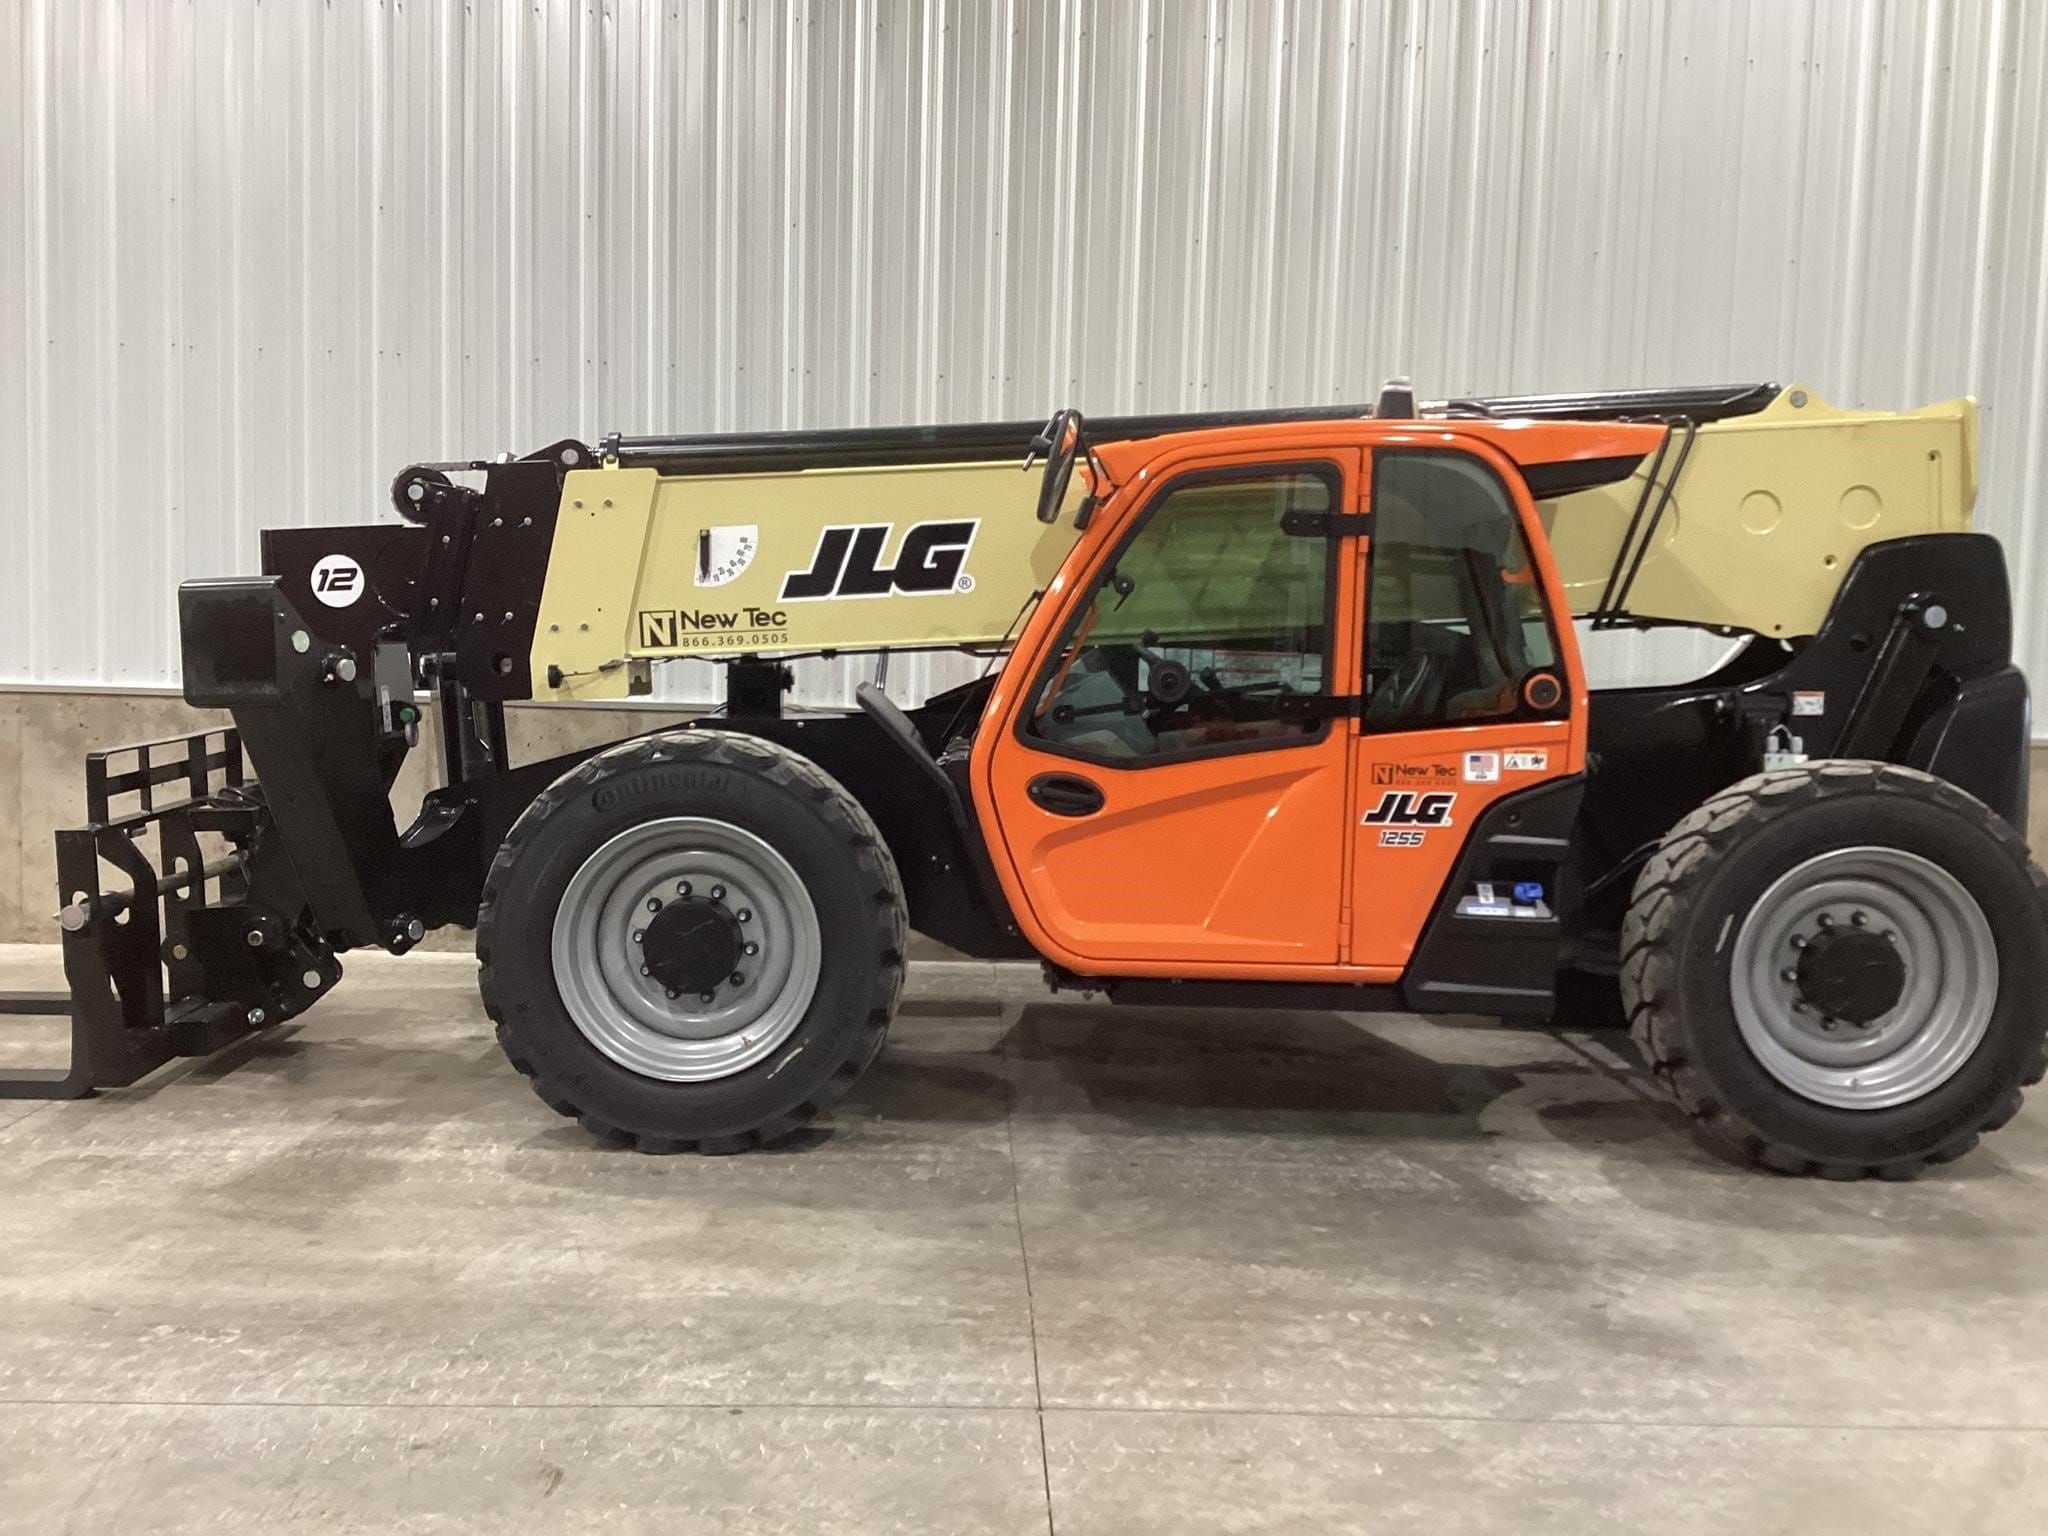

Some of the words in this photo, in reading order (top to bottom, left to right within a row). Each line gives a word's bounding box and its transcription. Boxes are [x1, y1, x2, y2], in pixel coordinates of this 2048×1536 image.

[780, 520, 979, 601] JLG
[317, 567, 358, 592] 12
[680, 609, 739, 631] New
[742, 607, 788, 628] Tec
[682, 632, 789, 648] 866.369.0505
[1395, 763, 1430, 777] New
[1431, 763, 1457, 777] Tec
[1363, 793, 1456, 825] JLG
[1380, 831, 1425, 846] 1255
